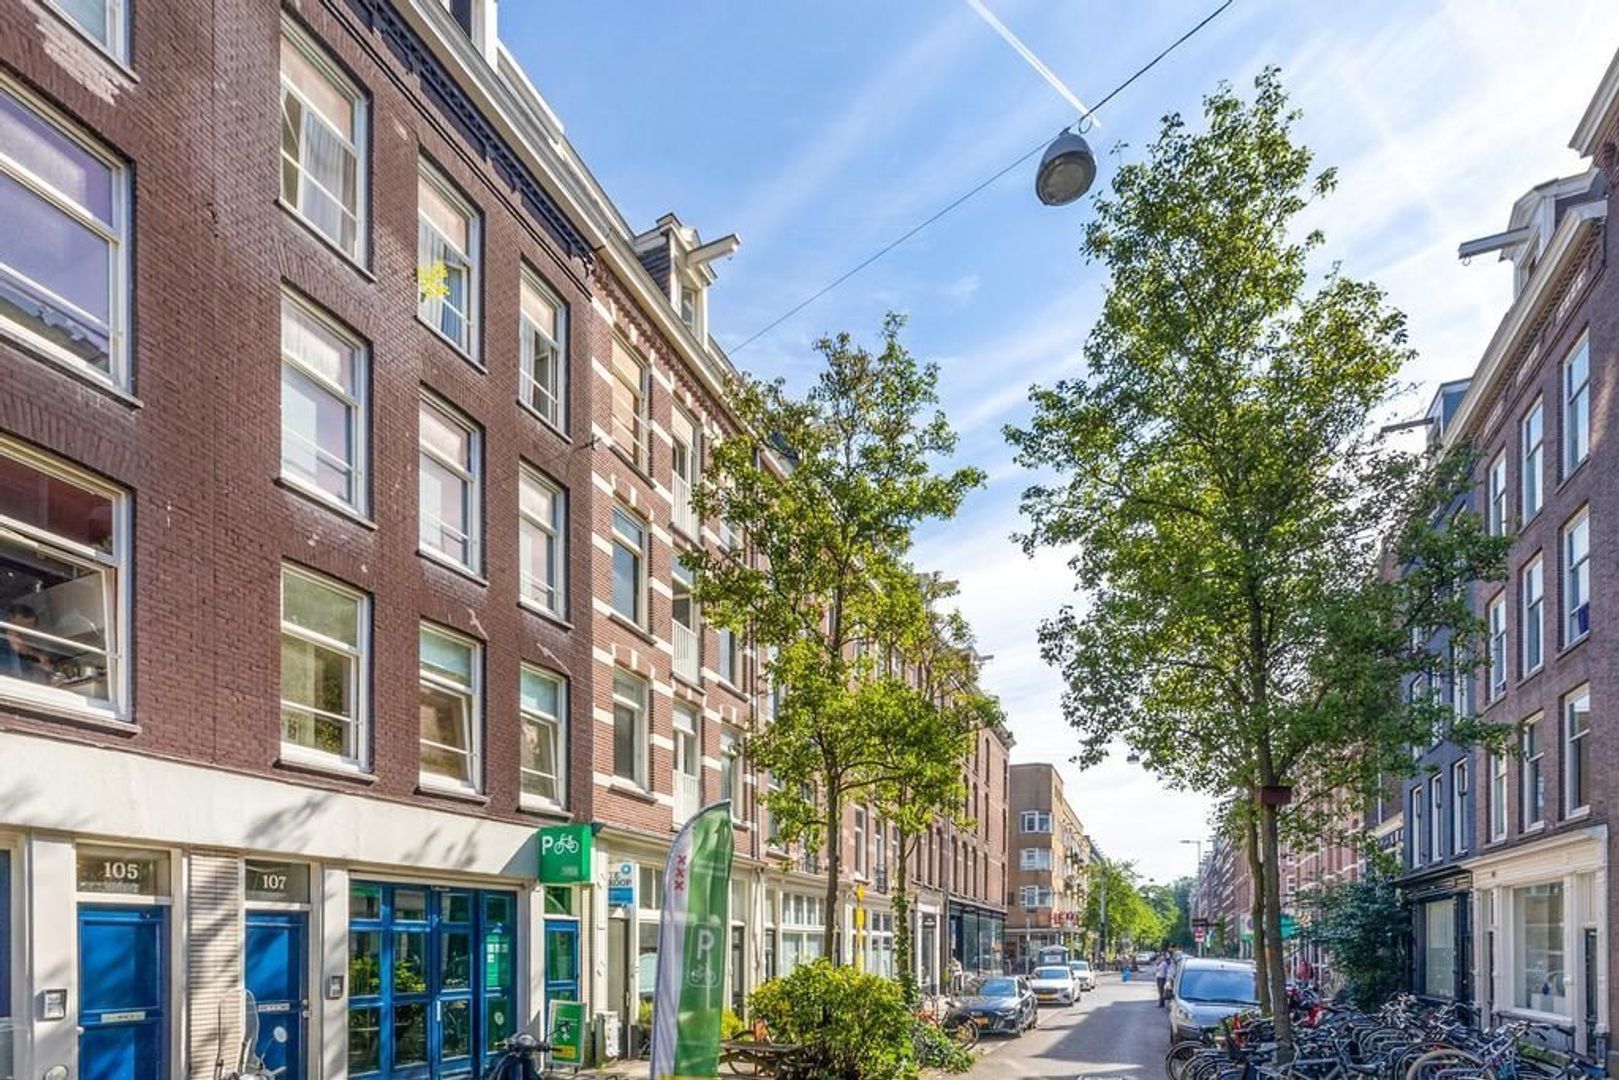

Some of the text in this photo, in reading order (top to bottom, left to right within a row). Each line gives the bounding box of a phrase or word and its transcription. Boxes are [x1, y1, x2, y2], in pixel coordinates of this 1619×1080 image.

[542, 836, 553, 856] P
[104, 862, 138, 880] 105
[263, 875, 287, 890] 107
[697, 928, 715, 960] P
